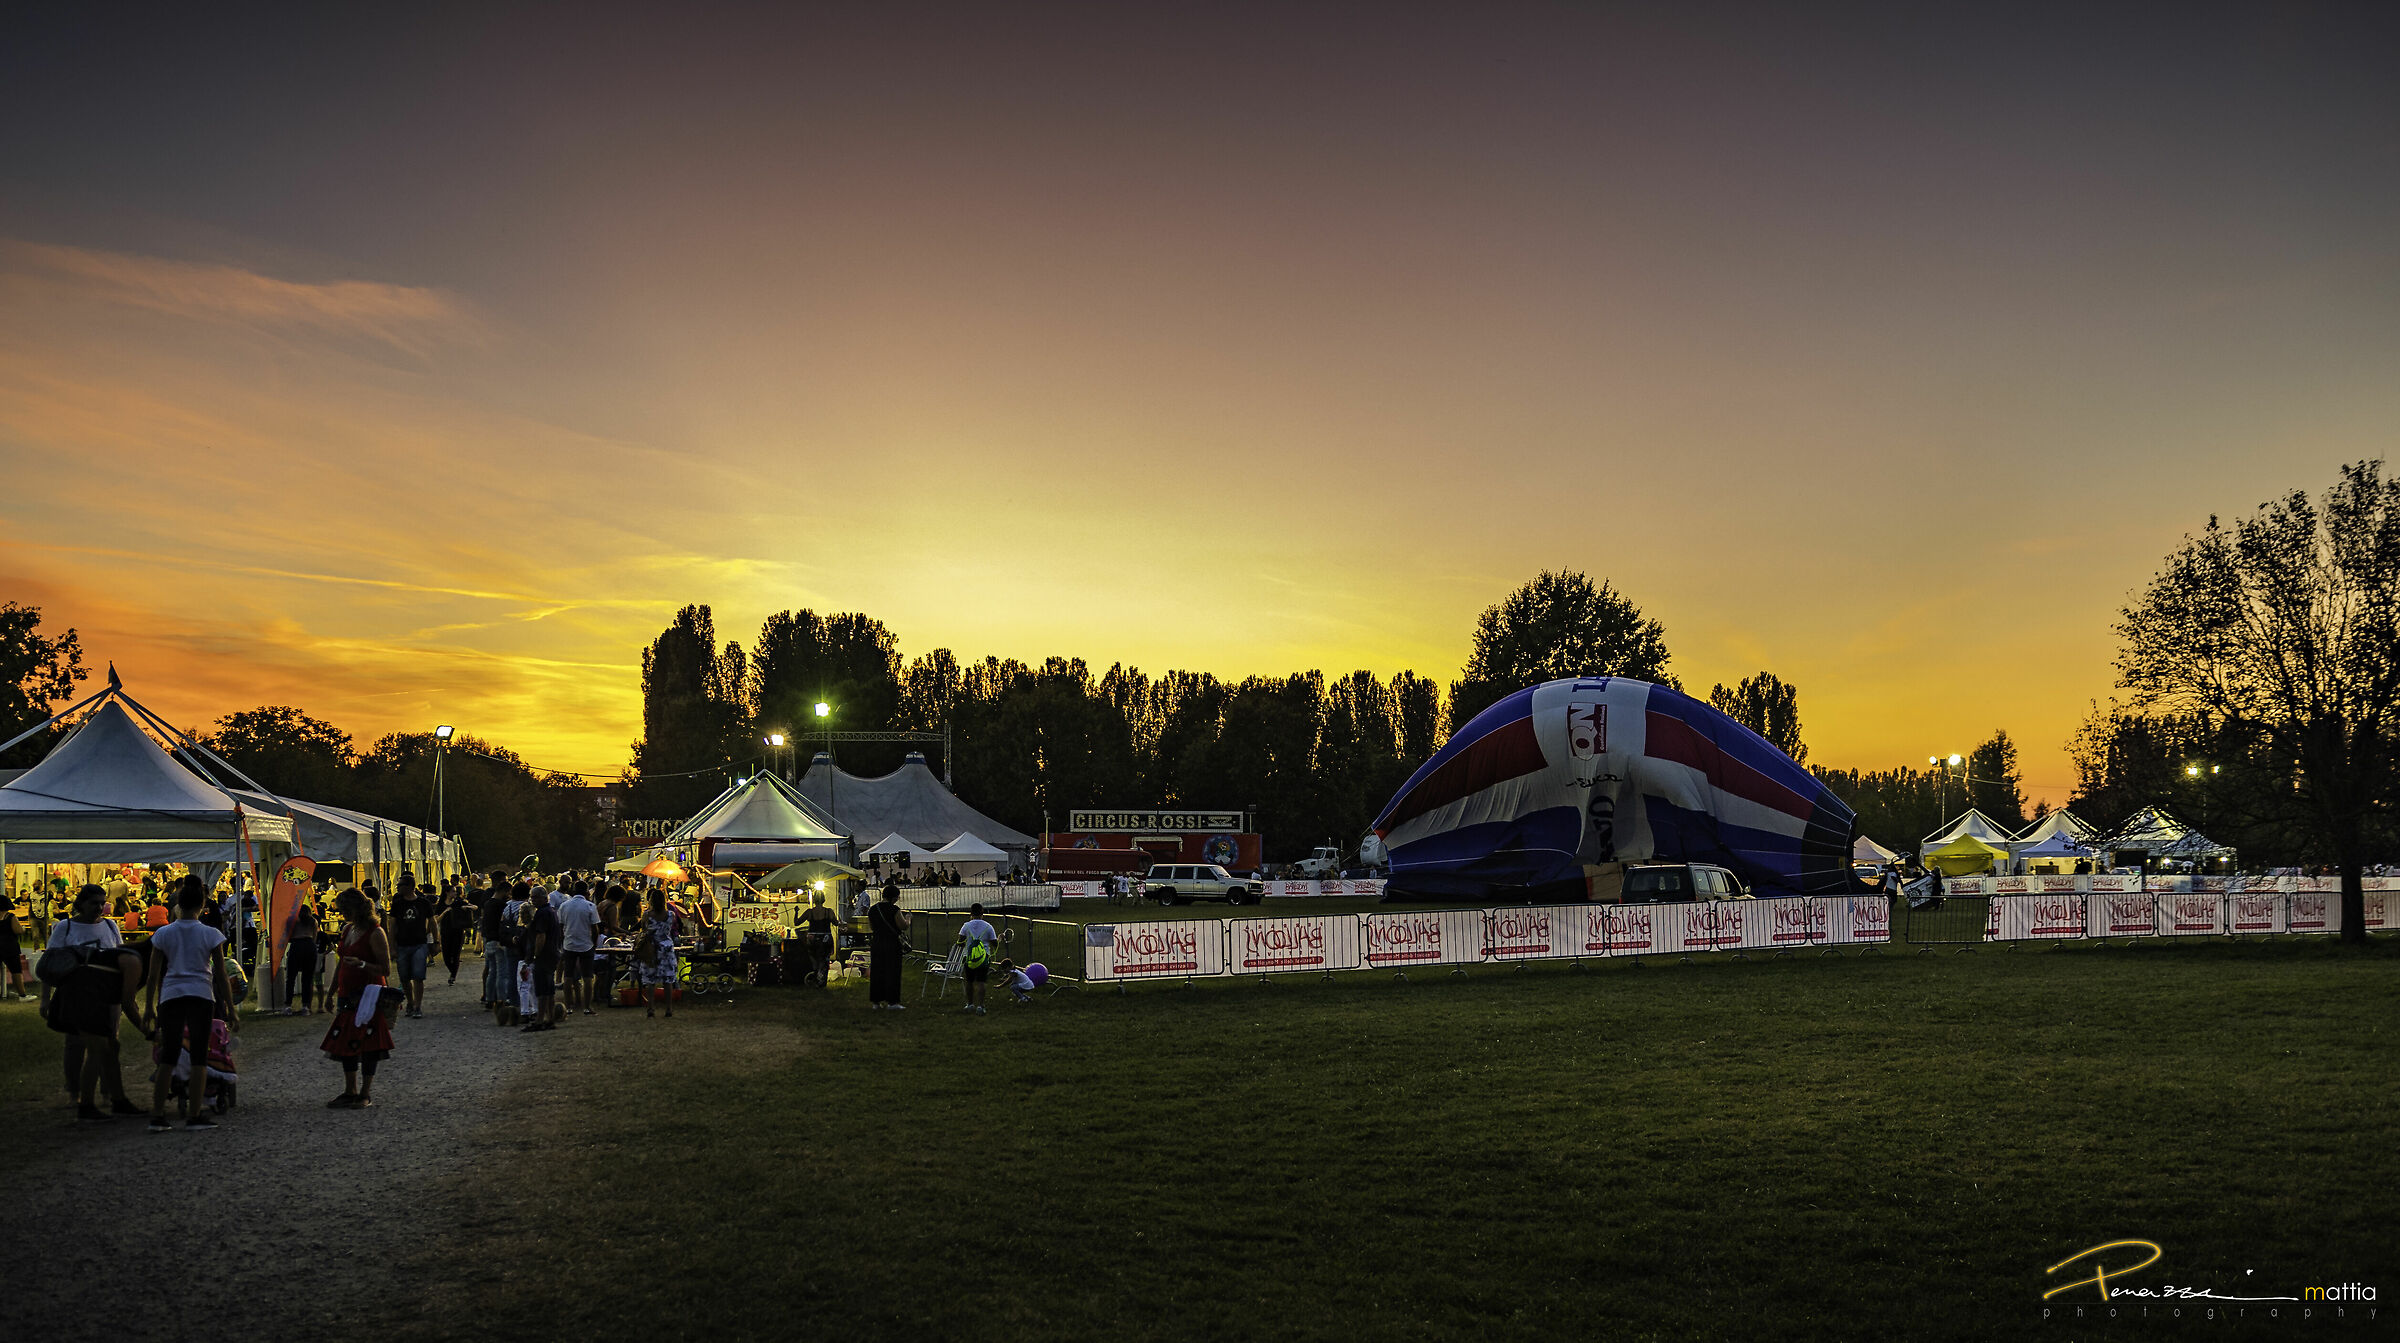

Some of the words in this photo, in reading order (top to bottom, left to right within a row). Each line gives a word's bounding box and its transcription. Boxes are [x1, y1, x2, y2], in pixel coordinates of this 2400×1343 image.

[1570, 702, 1597, 761] QN
[1075, 813, 1140, 829] CIRCUS
[1147, 813, 1202, 829] ROSSI
[729, 907, 779, 920] CREPES
